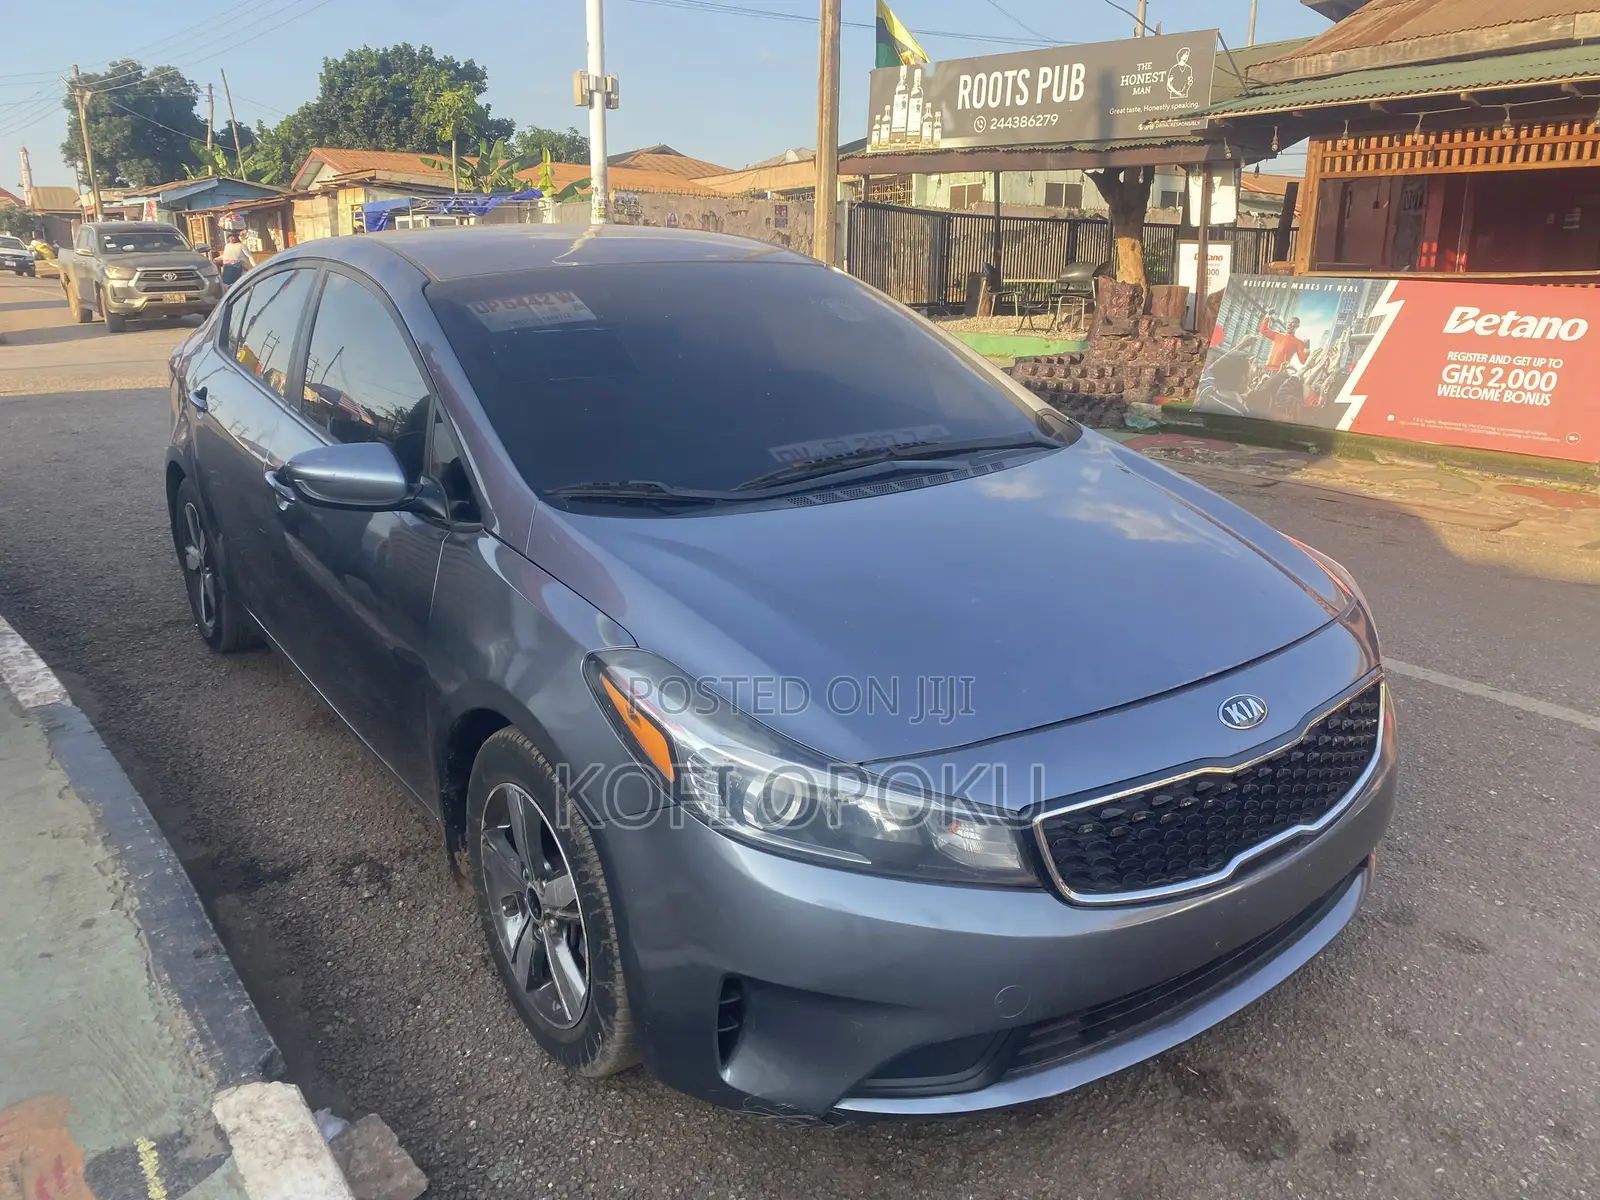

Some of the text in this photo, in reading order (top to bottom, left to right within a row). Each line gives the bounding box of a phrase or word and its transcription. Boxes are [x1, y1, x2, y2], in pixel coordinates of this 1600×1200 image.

[1136, 62, 1153, 71] THE
[957, 62, 1086, 110] ROOTS PUB
[1120, 70, 1167, 87] HONEST
[1132, 86, 1152, 96] MAN
[1109, 107, 1126, 115] Great
[1143, 103, 1171, 112] Honestly
[989, 113, 1059, 130] 244386279
[1243, 280, 1287, 289] BELIEVING
[1291, 282, 1320, 291] MAKES
[1336, 284, 1359, 293] REAL
[1442, 306, 1589, 341] Betano
[1447, 350, 1564, 369] REGISTER AND GET UP TO
[1441, 364, 1558, 392] GHS 2,000
[1437, 383, 1552, 406] WELCOME BONUS
[1224, 697, 1265, 724] KIA
